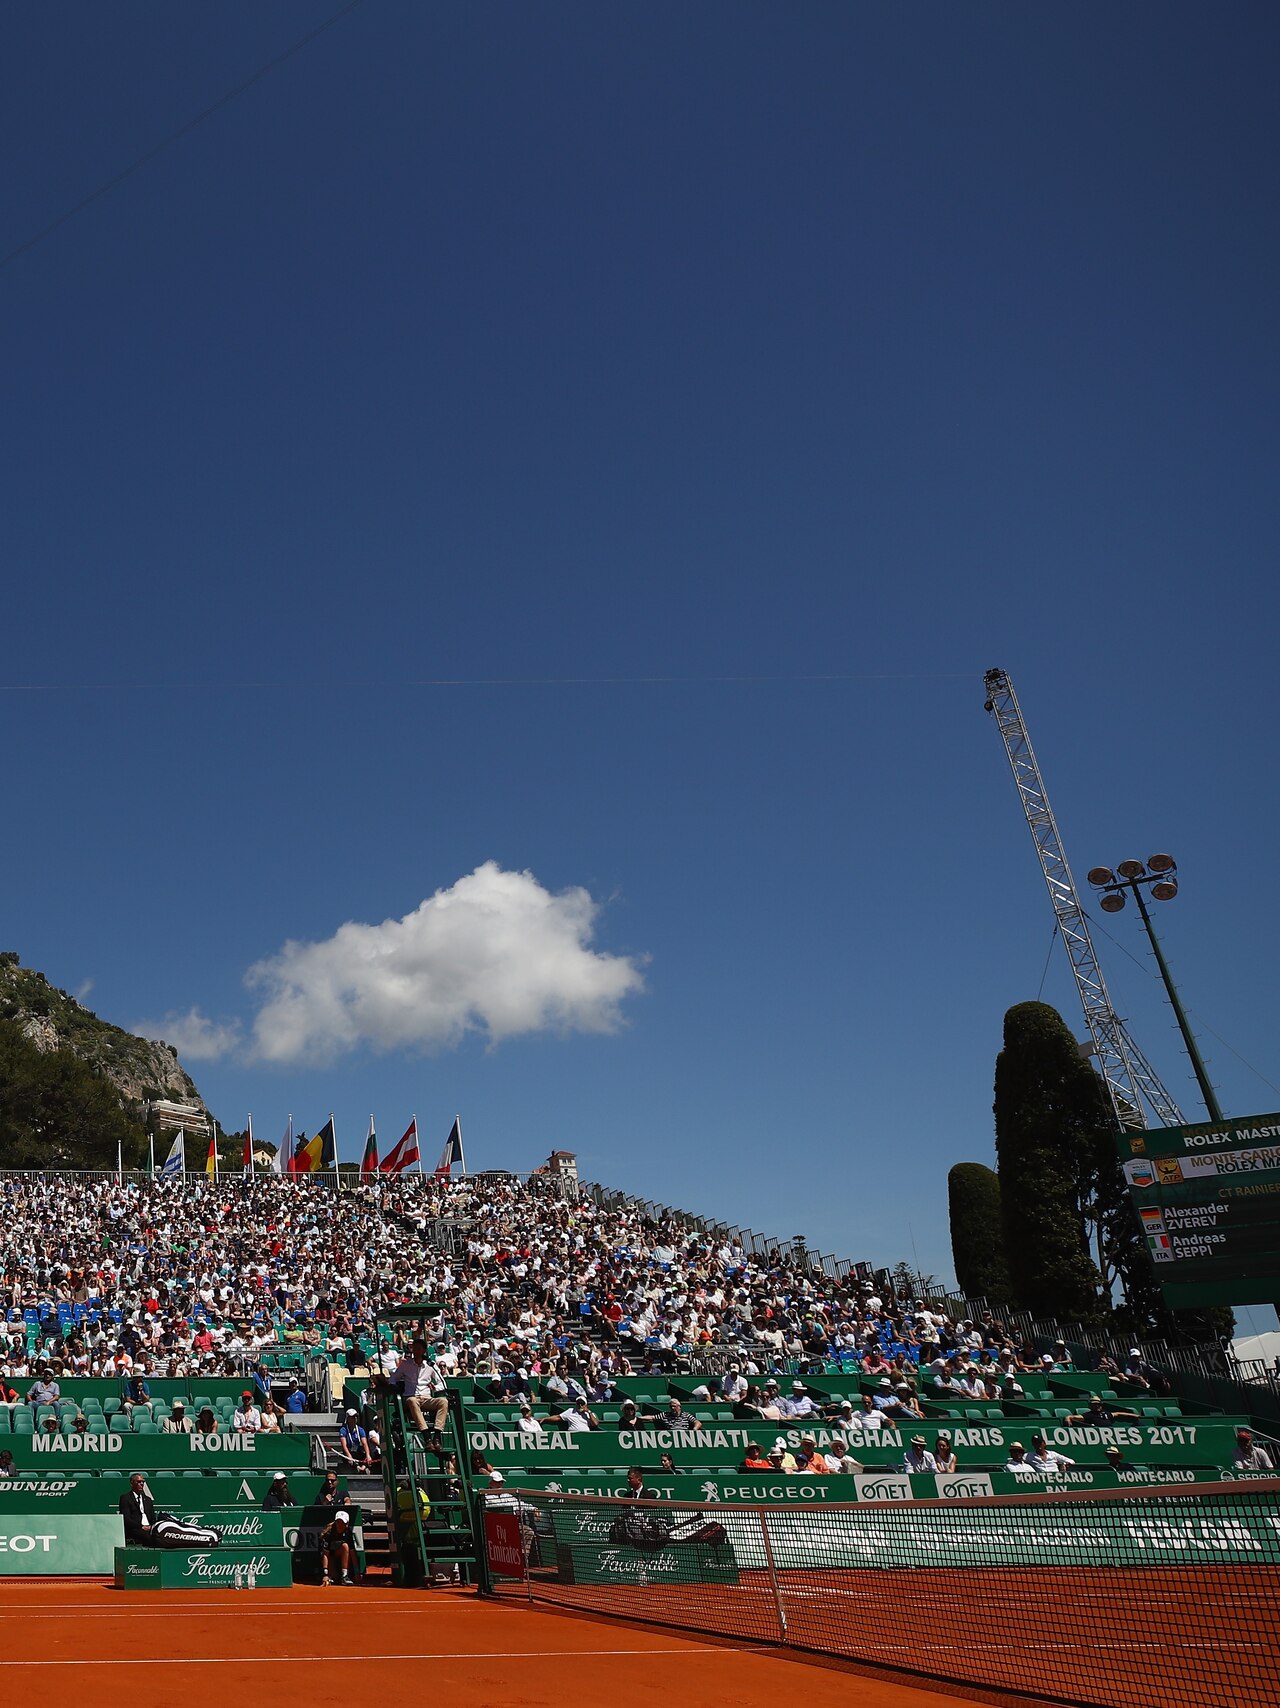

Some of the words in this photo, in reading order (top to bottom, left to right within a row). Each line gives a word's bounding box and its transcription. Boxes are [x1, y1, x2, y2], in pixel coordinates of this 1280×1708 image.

[1183, 1132, 1233, 1148] ROLEX
[1216, 1160, 1260, 1174] ROLEX
[1162, 1174, 1181, 1183] ATP
[1218, 1188, 1233, 1198] CT
[1164, 1203, 1230, 1219] Alexander
[1146, 1223, 1162, 1231] GER
[1166, 1215, 1217, 1230] ZVEREV
[1172, 1233, 1227, 1247] Andreas
[1156, 1252, 1170, 1260] ITA
[1175, 1245, 1213, 1259] SEPPI
[32, 1433, 123, 1452] MADRID
[190, 1433, 257, 1452] ROME
[471, 1431, 580, 1450] ONTREAL
[618, 1429, 750, 1450] CINCINNATI
[1040, 1427, 1143, 1446] LONDRES
[1147, 1427, 1197, 1445] 2017
[1015, 1472, 1094, 1484] MONTE-CARLO
[1118, 1471, 1195, 1483] MONTE-CARLO
[723, 1486, 829, 1499] PEUGEOT
[164, 1532, 211, 1542] PROKENNEX
[496, 1524, 507, 1543] Fly
[488, 1540, 521, 1566] Emirates
[182, 1553, 271, 1579] Façonnable
